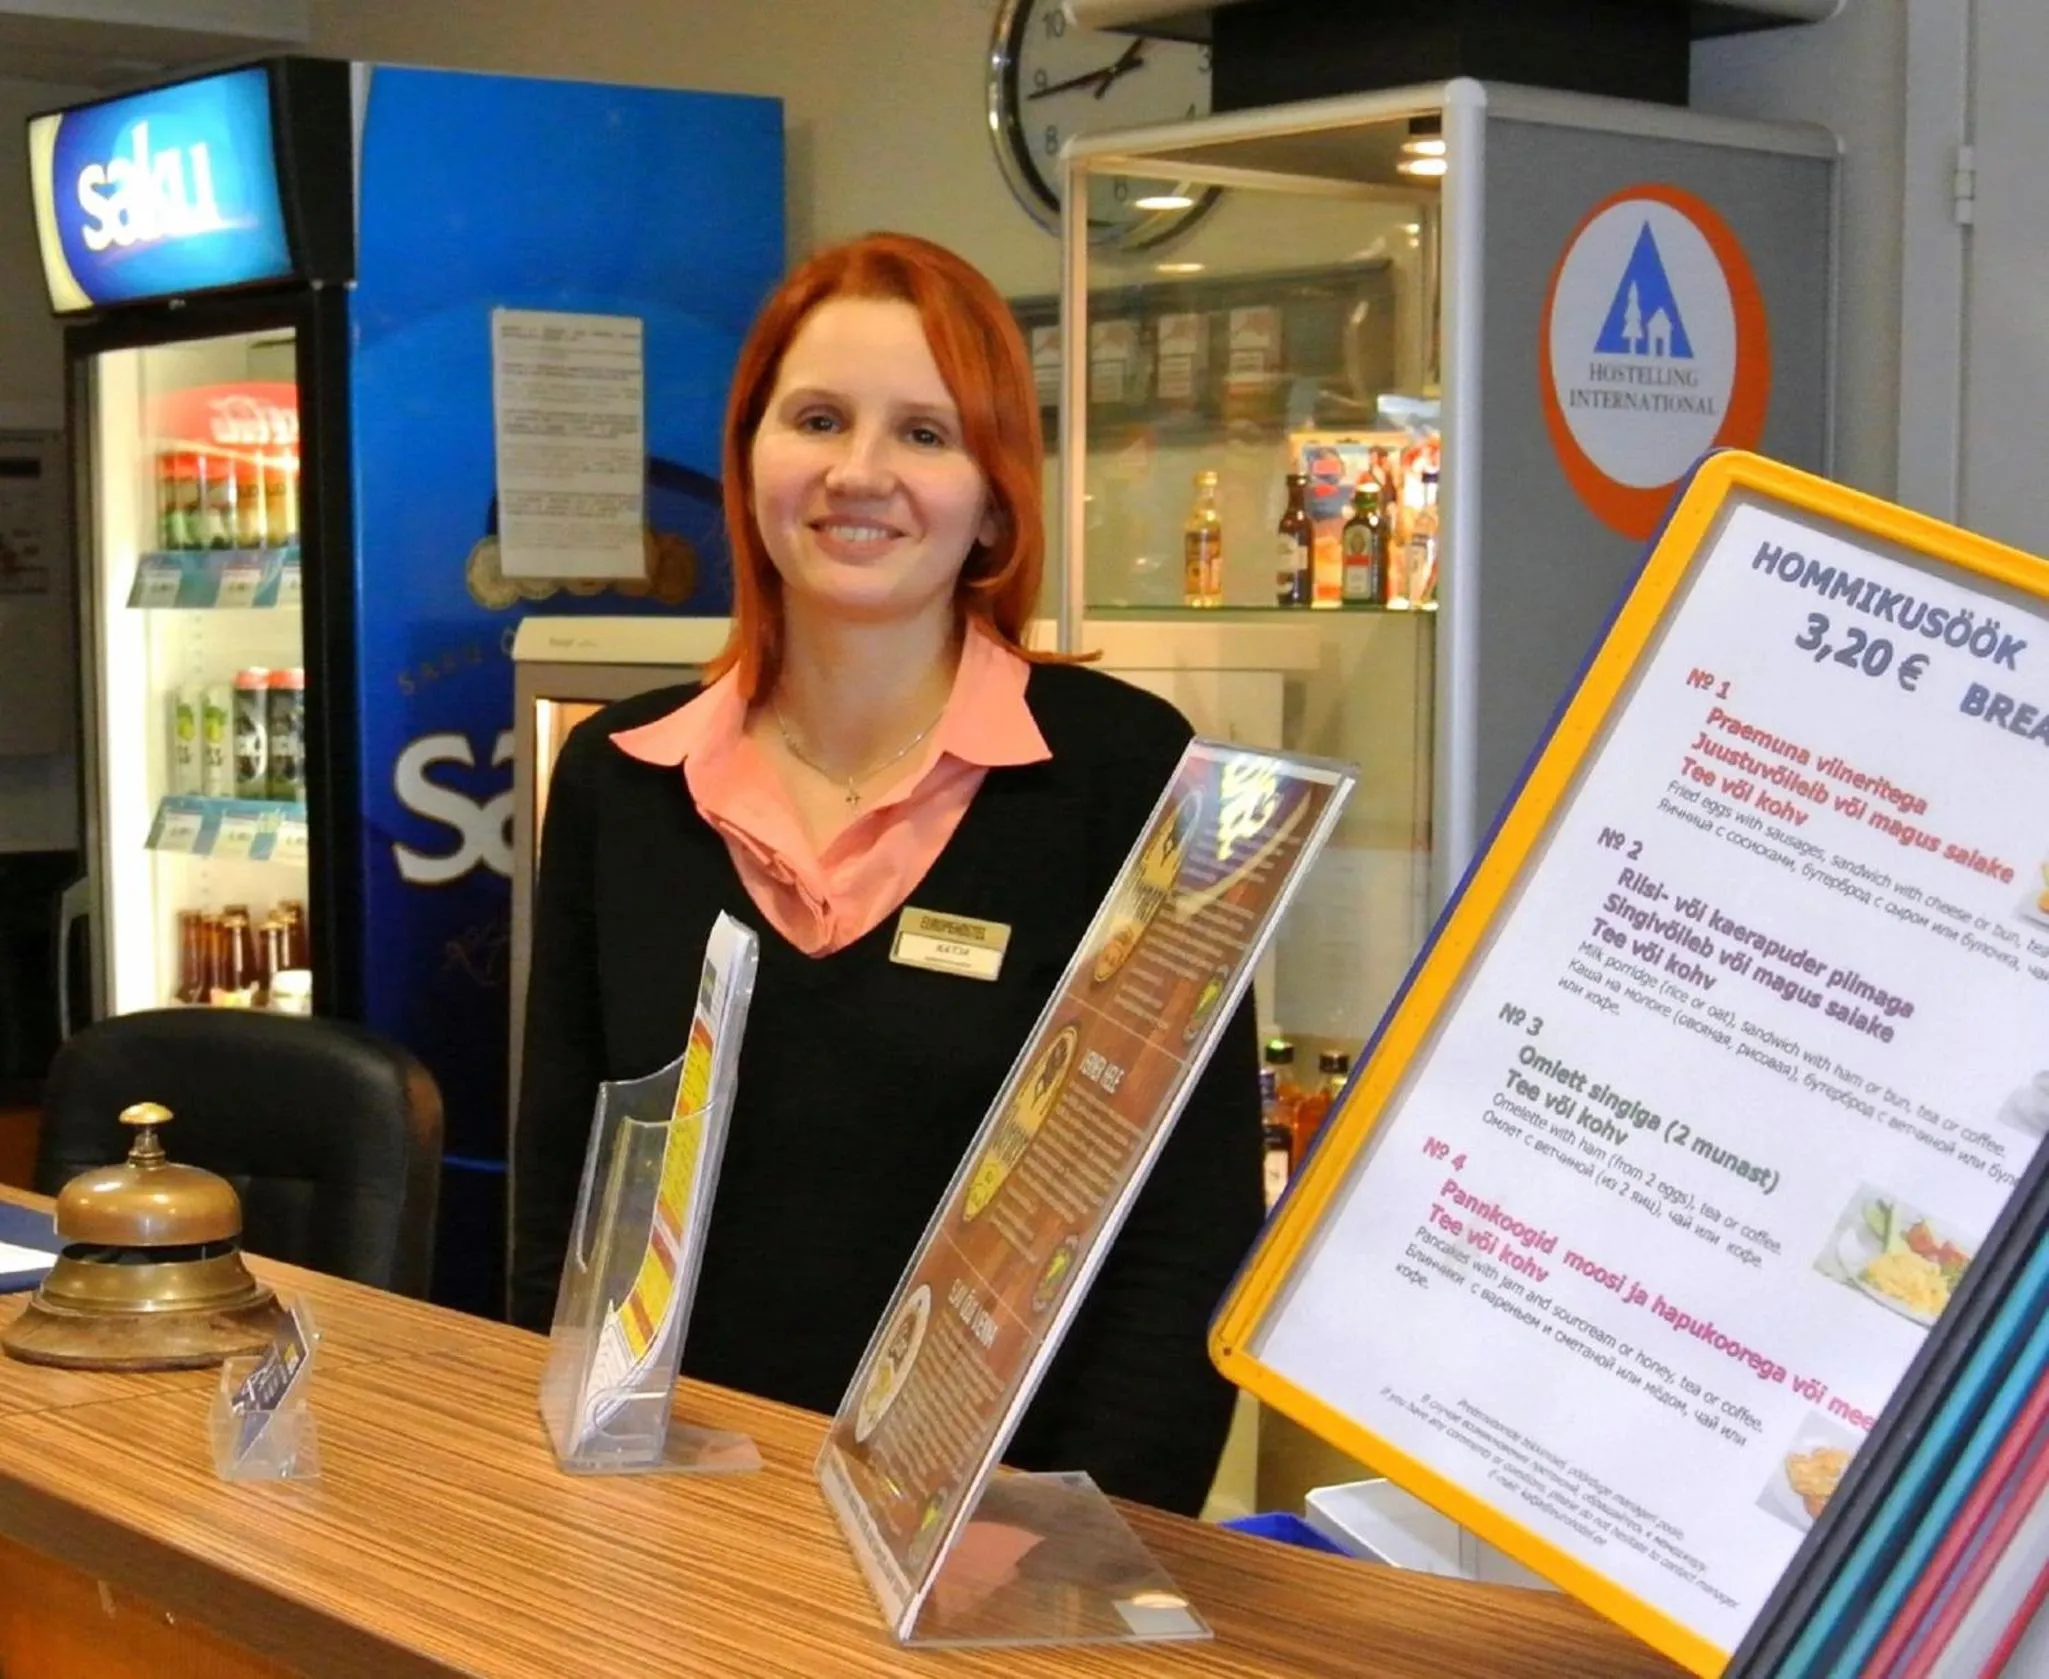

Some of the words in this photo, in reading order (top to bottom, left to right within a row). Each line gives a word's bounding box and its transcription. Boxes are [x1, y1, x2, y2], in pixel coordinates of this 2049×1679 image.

[1043, 9, 1066, 38] 10
[77, 119, 222, 252] saku
[1569, 388, 1719, 416] INTERNATIONAL
[1589, 362, 1700, 387] HOSTELLING
[1750, 540, 2027, 671] HOMMIKUSÖÖK
[1714, 680, 1731, 700] 1
[1794, 611, 1894, 677] 3,20
[1896, 652, 1930, 692] €
[1680, 755, 1717, 788] Tee
[1720, 776, 1755, 803] või
[1753, 788, 1809, 826] kohv
[1704, 705, 1811, 766] Praemuna
[1815, 755, 1928, 816] viineritega
[1690, 730, 1829, 805] Juustuvõileib
[1833, 794, 1869, 820] või
[1866, 809, 1942, 853] magus
[1941, 842, 2014, 884] saiake
[1625, 839, 1643, 861] 2
[1656, 796, 1714, 832] Яичница
[1725, 829, 1796, 873] сосисками,
[1800, 861, 1872, 905] бутерброд
[1666, 778, 1702, 803] Fried
[1699, 795, 1733, 819] eggs
[1734, 811, 1764, 831] with
[1763, 825, 1826, 863] sausages,
[1829, 853, 1892, 888] sandwich
[1892, 882, 1924, 902] with
[1923, 894, 1973, 923] cheese
[1972, 916, 1991, 931] or
[1590, 915, 1628, 949] Tee
[1631, 938, 1665, 966] või
[1662, 951, 1717, 991] kohv
[1616, 866, 1669, 902] Riisi-
[1673, 894, 1708, 923] või
[1706, 907, 1828, 977] kaerapuder
[1824, 968, 1915, 1019] piimaga
[1525, 1015, 1544, 1037] 3
[1567, 957, 1603, 984] Каша
[1603, 977, 1622, 993] на
[1622, 986, 1673, 1017] молоке
[1718, 948, 1754, 976] või
[1751, 965, 1823, 1009] magus
[1823, 999, 1895, 1044] saiake
[1577, 939, 1603, 962] Milk
[1602, 955, 1659, 989] porridge
[1657, 978, 1690, 1004] (rice
[1689, 996, 1706, 1009] or
[1739, 1019, 1801, 1057] sandwich
[1801, 1050, 1832, 1072] with
[1832, 1062, 1864, 1088] ham
[1864, 1080, 1883, 1094] or
[1881, 1086, 1911, 1114] bun,
[1915, 1103, 1940, 1126] tea
[1940, 1118, 1960, 1132] or
[1959, 1126, 2005, 1158] coffee.
[1505, 1067, 1541, 1102] Tee
[1543, 1091, 1578, 1119] või
[1575, 1104, 1629, 1146] kohv
[1517, 1044, 1588, 1093] Omlett
[1586, 1083, 1662, 1132] singiga
[1662, 1118, 1691, 1146] (2
[1689, 1136, 1780, 1196] munast)
[1450, 1153, 1467, 1172] 4
[1481, 1108, 1524, 1138] Омлет
[1617, 1181, 1631, 1197] 2
[1491, 1091, 1549, 1130] Omelette
[1548, 1123, 1577, 1146] with
[1577, 1135, 1607, 1161] ham
[1606, 1152, 1644, 1182] (from
[1643, 1171, 1657, 1188] 2
[1656, 1180, 1695, 1211] eggs),
[1698, 1201, 1722, 1223] tea
[1722, 1215, 1740, 1229] or
[1739, 1224, 1781, 1255] coffee.
[1428, 1202, 1464, 1237] Tee
[1465, 1228, 1499, 1255] või
[1497, 1242, 1549, 1283] kohv
[1414, 1224, 1471, 1265] Pancakes
[1471, 1260, 1499, 1280] with
[1496, 1274, 1525, 1296] jam
[1524, 1289, 1553, 1311] and
[1550, 1304, 1617, 1349] sourcream
[1617, 1342, 1634, 1357] or
[1633, 1349, 1676, 1385] honey,
[1679, 1375, 1702, 1397] tea
[1702, 1390, 1721, 1405] or
[1719, 1400, 1762, 1433] coffee.
[1439, 1177, 1559, 1255] Pannkoogid
[1562, 1249, 1628, 1293] moosi
[1620, 1280, 1649, 1307] ja
[1650, 1294, 1787, 1384] hapukoorega
[1791, 1374, 1828, 1404] või
[1693, 1409, 1720, 1430] чай
[1719, 1425, 1747, 1446] или
